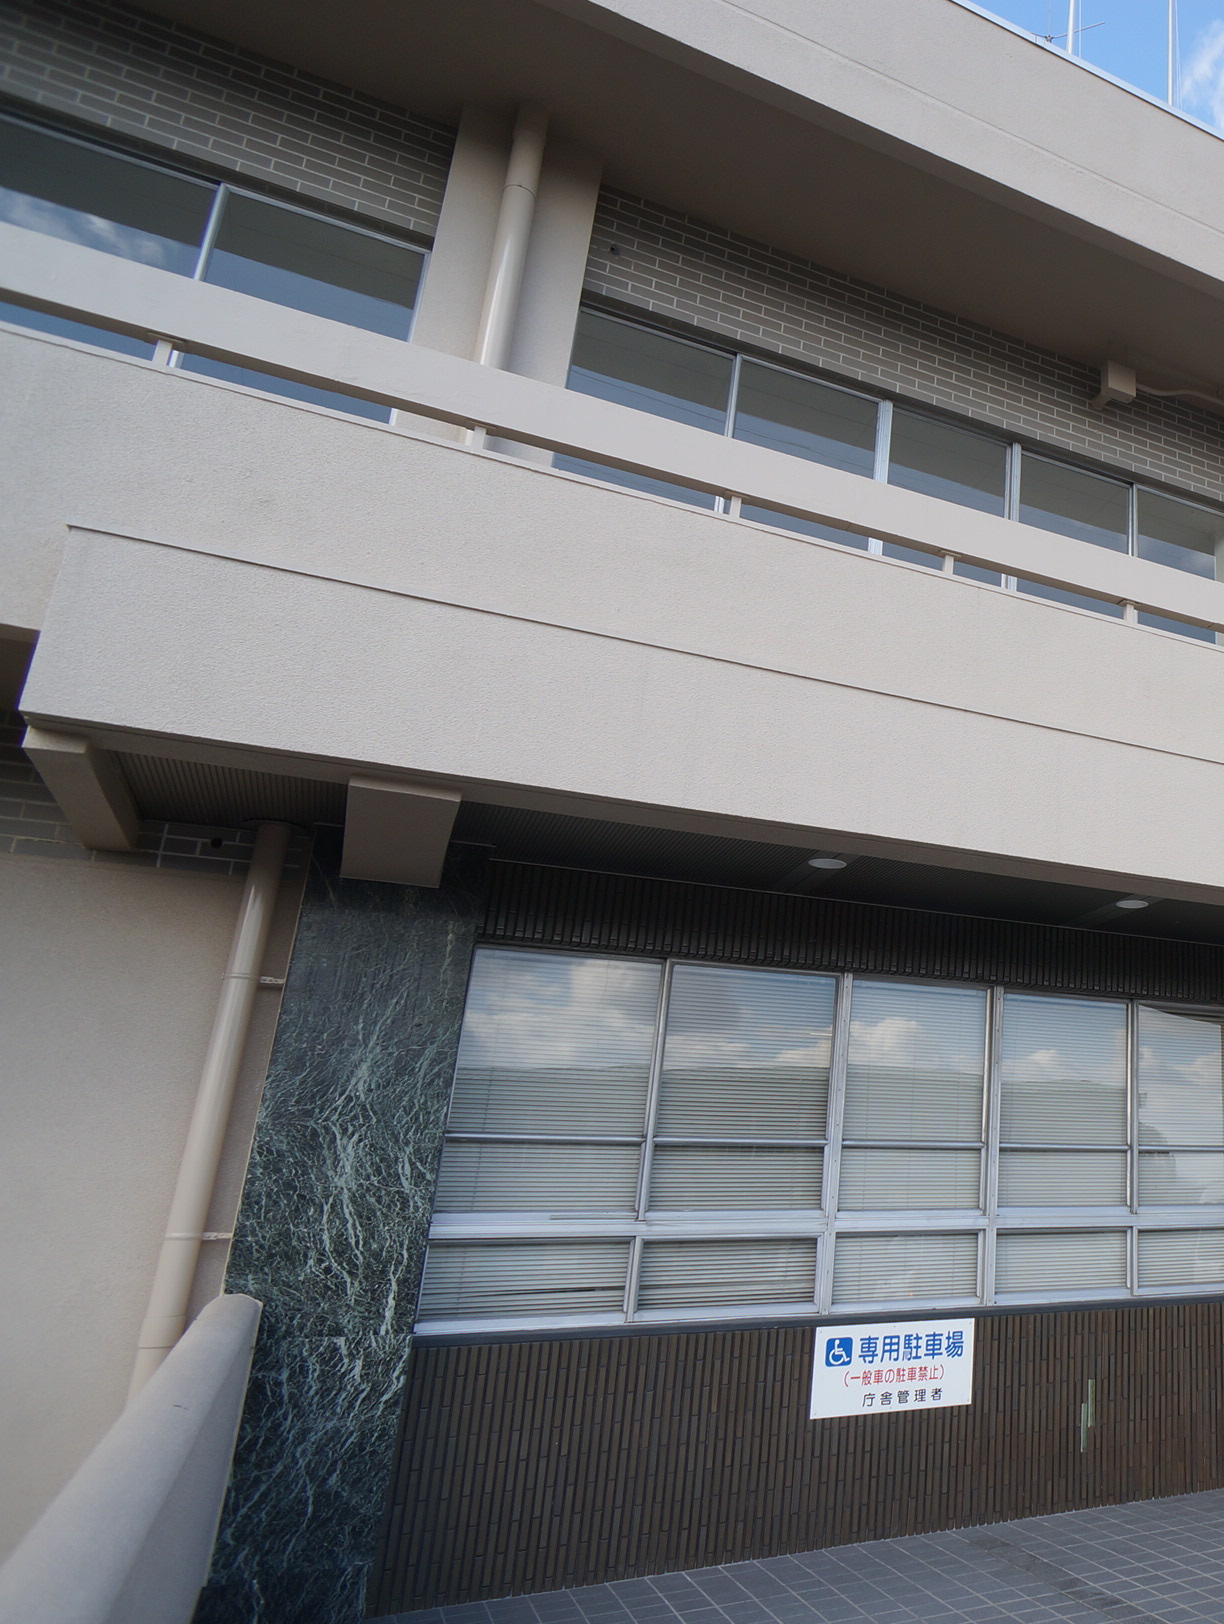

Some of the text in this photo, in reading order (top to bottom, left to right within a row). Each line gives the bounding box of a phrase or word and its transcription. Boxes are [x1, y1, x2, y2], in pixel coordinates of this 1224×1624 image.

[858, 1330, 965, 1365] 専用駐車場
[843, 1364, 946, 1387] （一般車の駐車禁止）
[862, 1387, 944, 1408] 庁舎管理者
